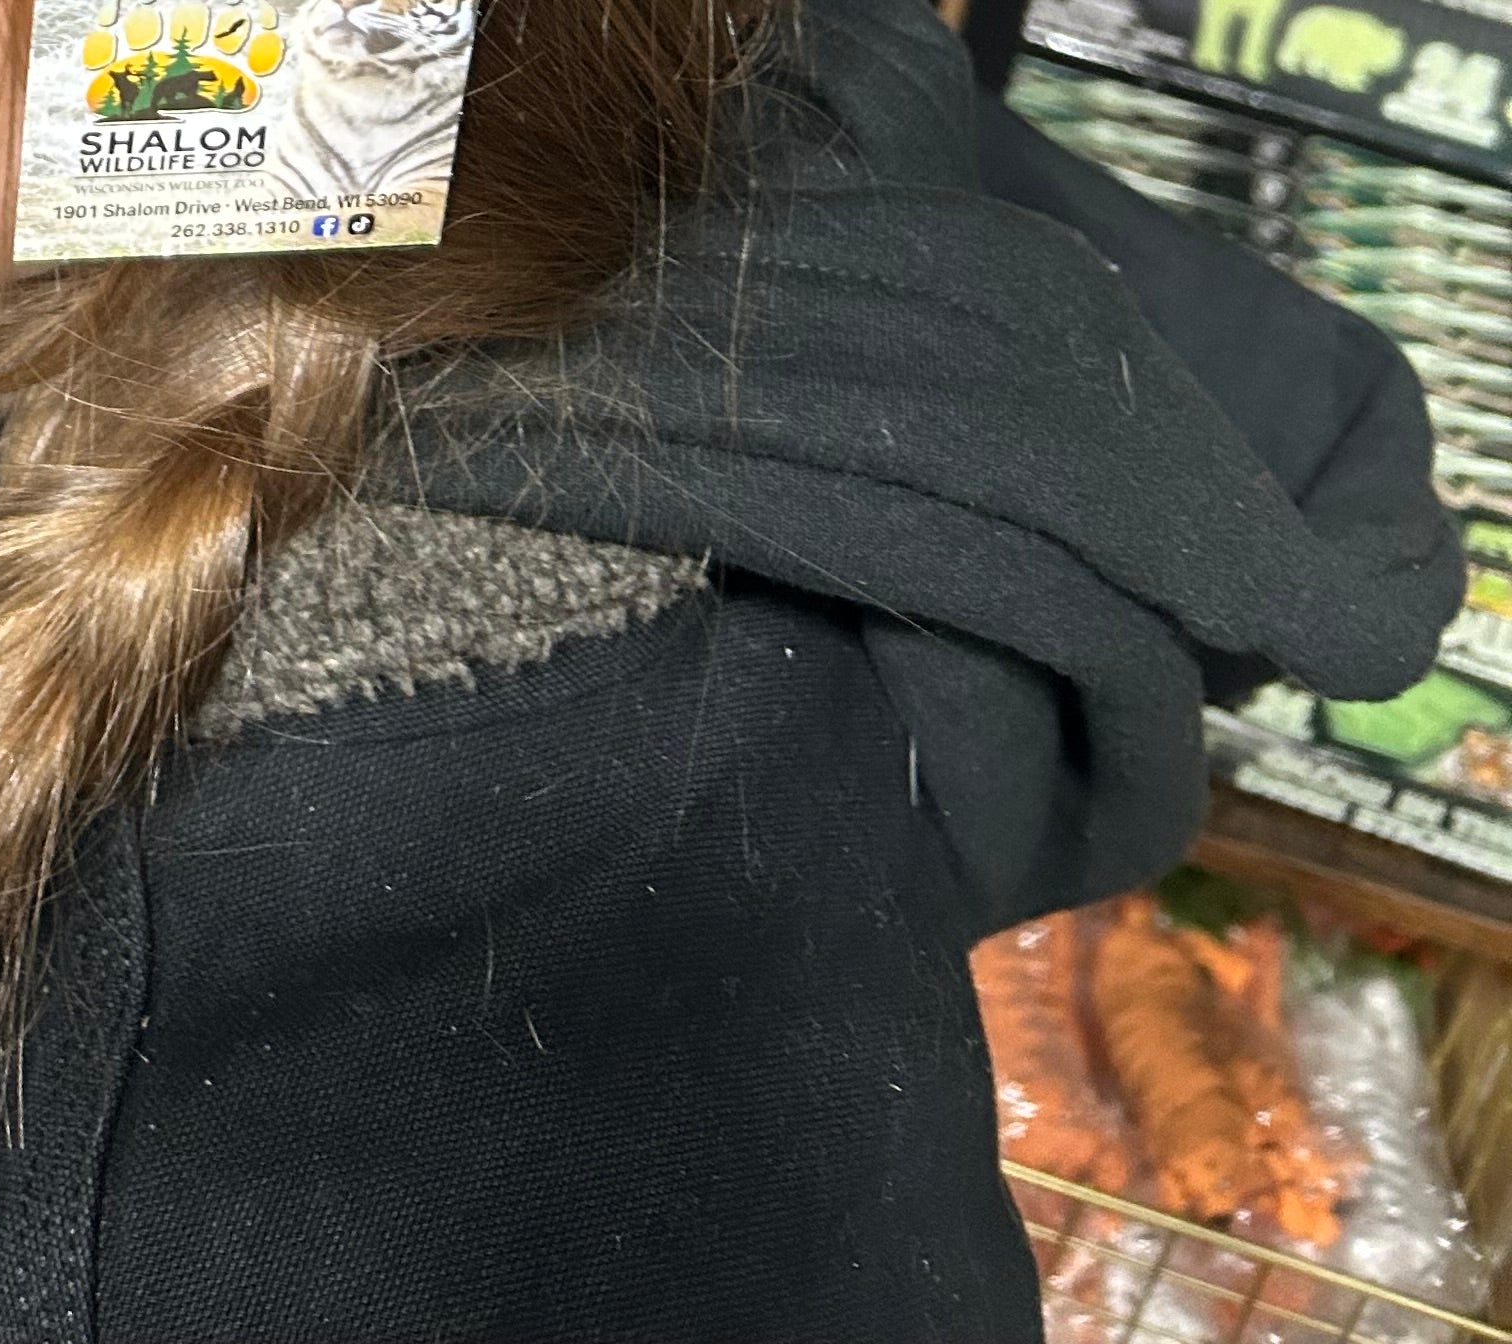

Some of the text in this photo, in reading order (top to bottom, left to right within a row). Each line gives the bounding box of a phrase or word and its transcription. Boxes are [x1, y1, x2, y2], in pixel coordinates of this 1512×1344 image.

[79, 125, 267, 156] SHALOM
[79, 151, 266, 174] WILDLIFE ZOO
[74, 178, 265, 195] WISCONSIN'S WILDEST ZOO
[53, 192, 423, 220] 1901 Shalom Drive West Bend, WI 53090
[170, 220, 300, 238] 262.338.1310
